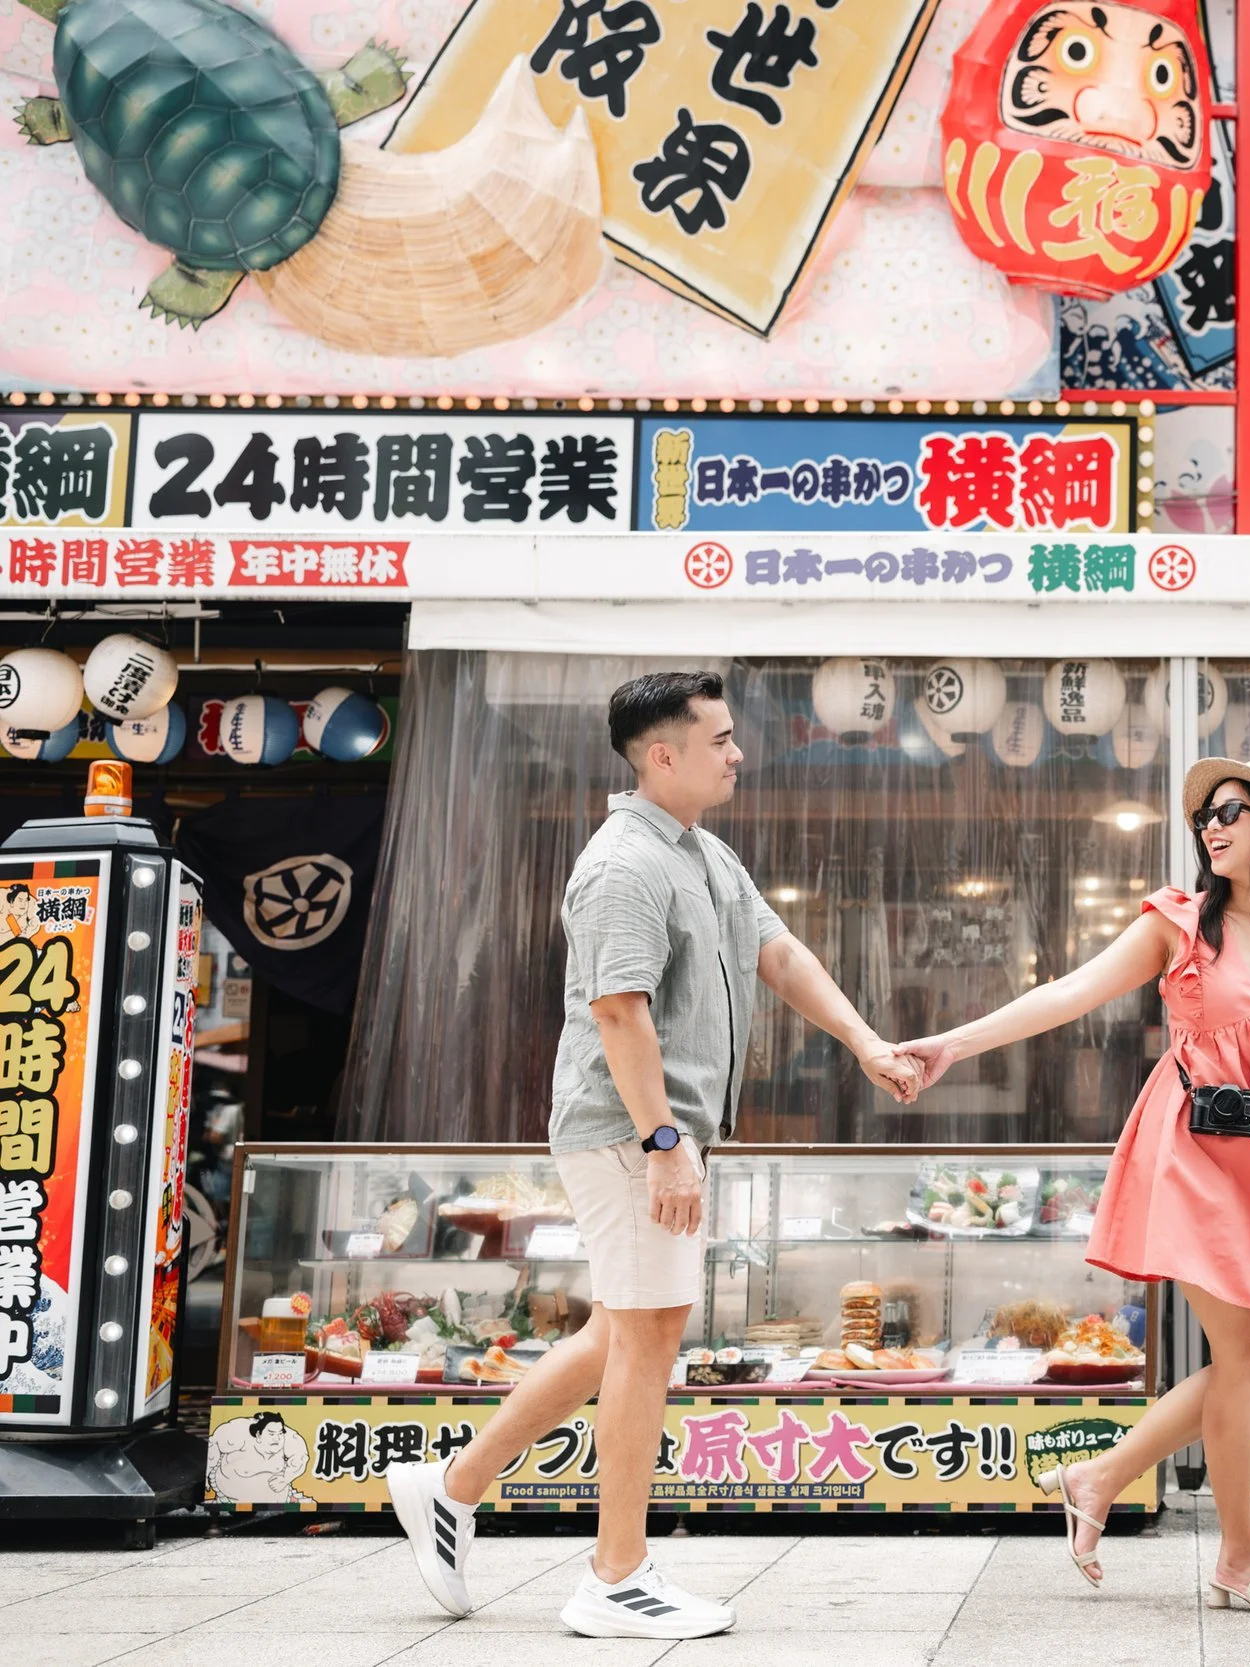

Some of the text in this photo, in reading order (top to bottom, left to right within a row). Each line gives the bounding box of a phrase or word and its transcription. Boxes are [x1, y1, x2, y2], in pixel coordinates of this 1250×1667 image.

[632, 0, 840, 235] 世界
[0, 427, 113, 520] 綱
[149, 432, 618, 522] 24時間営業
[697, 436, 1115, 528] 日本一の串かつ 横綱
[0, 538, 399, 587] 時間営業 年中無休
[746, 543, 1136, 592] 日本一の串かつ 横綱
[1060, 662, 1087, 723] 新鮮逸品
[36, 896, 87, 922] 横綱
[38, 888, 91, 897] 日本一の串かつ
[316, 1411, 1014, 1483] 料理サプは原寸大です!!
[1027, 1426, 1134, 1451] 味もボリューム
[506, 1486, 534, 1496] Food
[537, 1486, 577, 1498] sample
[580, 1486, 590, 1496] is
